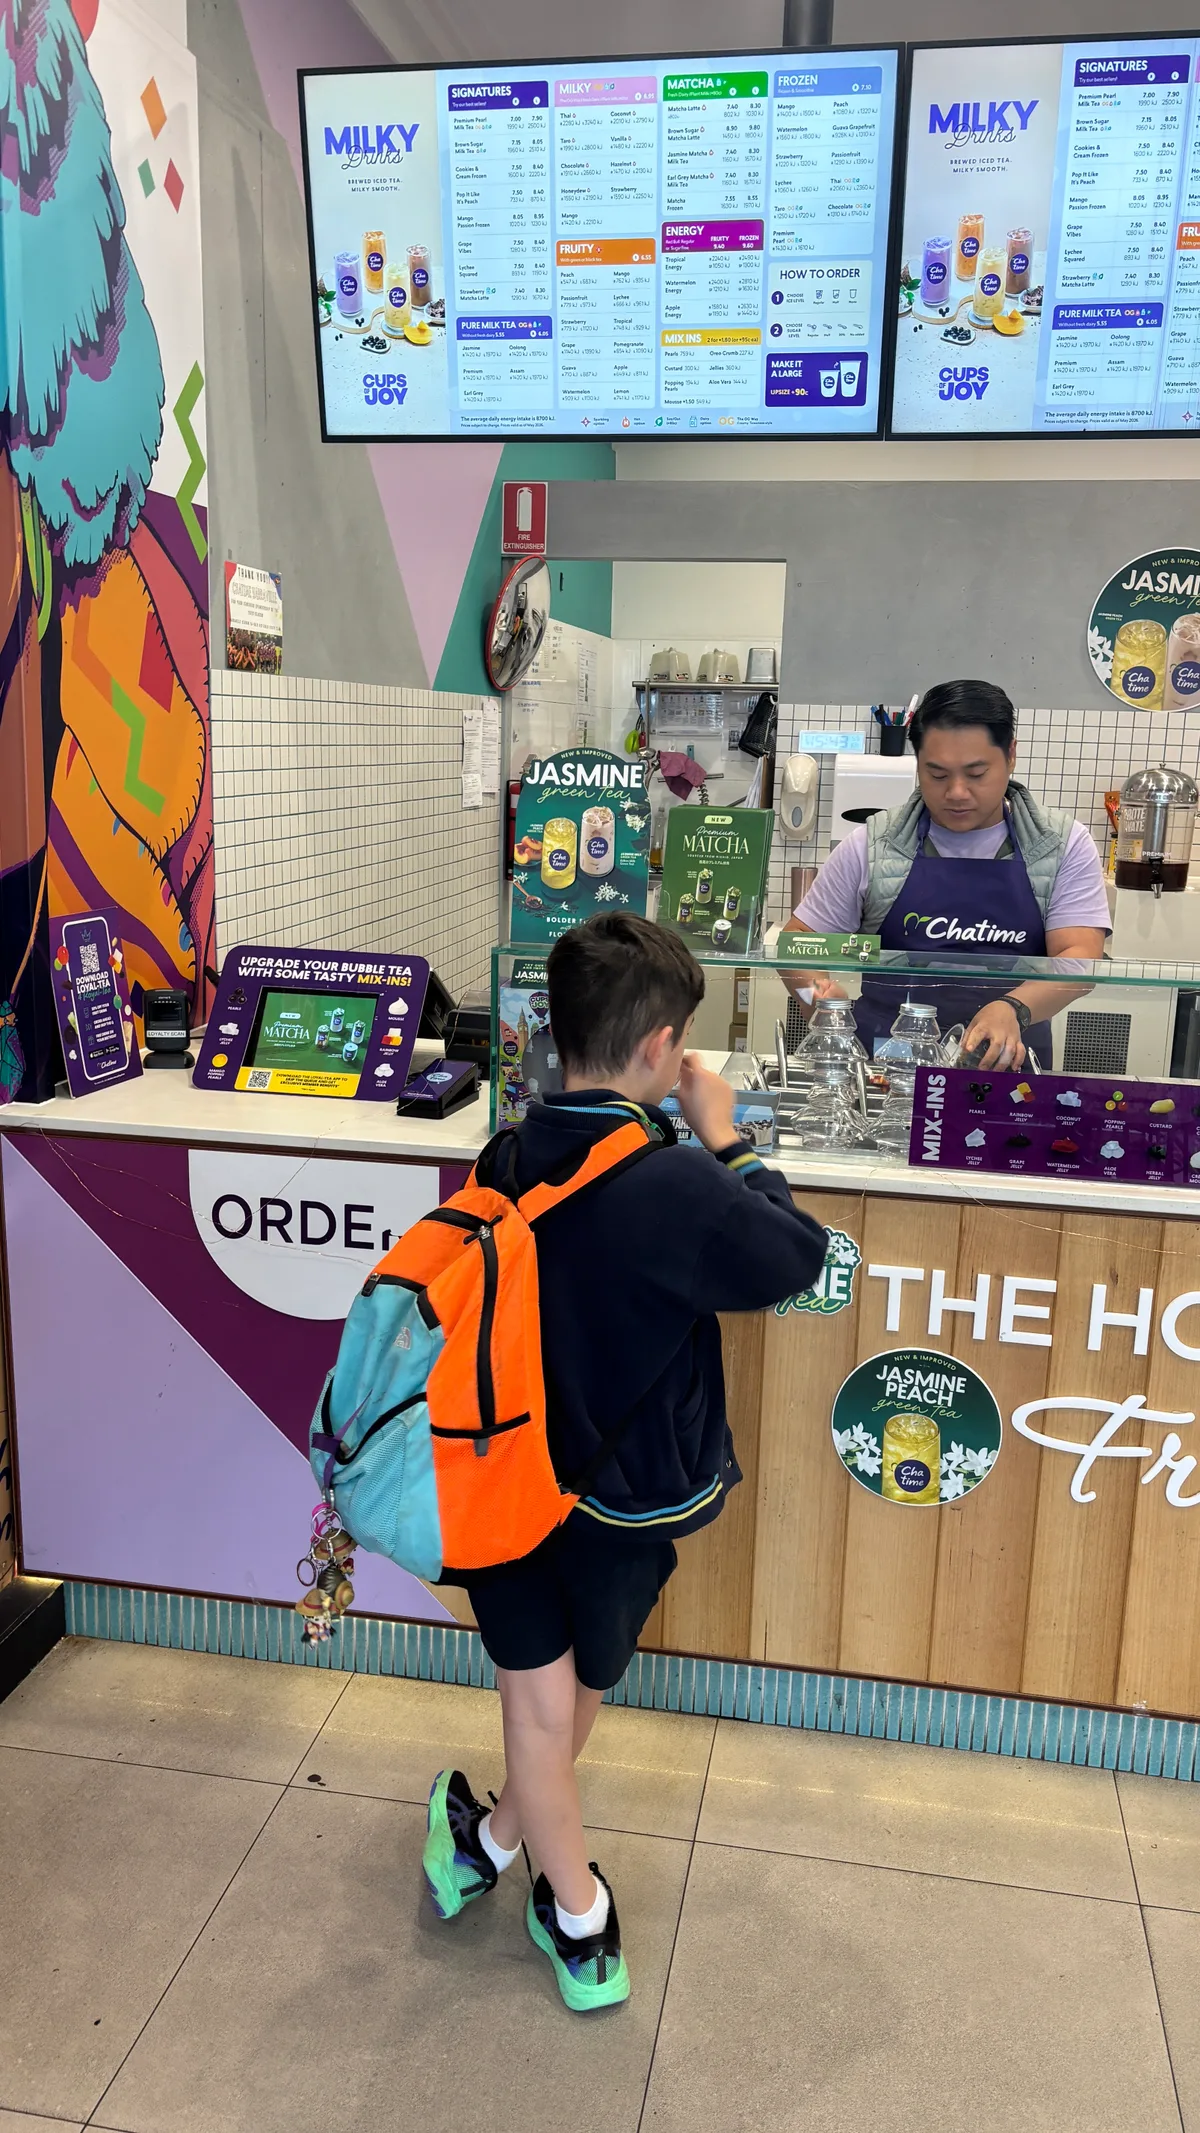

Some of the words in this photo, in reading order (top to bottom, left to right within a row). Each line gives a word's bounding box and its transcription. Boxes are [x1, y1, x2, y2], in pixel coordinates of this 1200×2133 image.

[1079, 60, 1147, 73] SIGNATURES
[668, 78, 714, 89] MATCHA
[778, 75, 818, 86] FROZEN
[452, 86, 512, 98] SIGNATURES
[560, 83, 591, 94] MILKY
[928, 100, 1039, 134] MILKY
[324, 124, 420, 155] MILKY
[944, 122, 1016, 150] Drinks
[341, 144, 403, 170] Drinks
[666, 226, 704, 236] ENERGY
[560, 244, 594, 254] FRUITY
[963, 241, 976, 250] Cha
[1012, 258, 1026, 266] Cha
[780, 270, 807, 279] HOW
[810, 270, 827, 278] TO
[827, 269, 860, 278] ORDER
[930, 267, 944, 276] Cha
[983, 278, 998, 286] Cha
[1059, 309, 1081, 318] PURE
[1082, 309, 1103, 317] MILK
[1105, 308, 1122, 316] TEA
[462, 321, 481, 329] PURE
[482, 320, 500, 329] MILK
[501, 320, 516, 328] TEA
[665, 334, 684, 344] MIX
[686, 334, 701, 343] INS
[795, 360, 802, 368] IT
[771, 370, 777, 378] A
[939, 367, 989, 381] CUPS
[363, 374, 407, 388] CUPS
[364, 388, 408, 405] JOY
[939, 382, 989, 400] JOY
[1152, 559, 1168, 567] NEW
[1178, 558, 1199, 566] IMPRO
[1130, 593, 1185, 607] green
[1128, 672, 1150, 683] Cha
[1177, 677, 1198, 688] time
[1128, 683, 1149, 692] time
[582, 750, 613, 760] IMPROVED
[526, 762, 642, 788] JASMINE
[537, 786, 596, 803] green
[696, 826, 738, 836] Premium
[683, 835, 749, 854] MATCHA
[926, 916, 1027, 944] Chatime
[787, 946, 829, 955] MATCHA
[241, 956, 301, 968] UPGRADE
[303, 960, 338, 971] YOUR
[341, 963, 385, 974] BUBBLE
[388, 966, 412, 976] TEA
[76, 971, 109, 985] DOWNLOAD
[238, 967, 272, 978] WITH
[275, 969, 311, 979] SOME
[313, 971, 352, 983] TASTY
[357, 975, 412, 986] MIX-INS!
[76, 980, 110, 994] LOYAL-TEA
[264, 1026, 310, 1040] MATCHA
[922, 1074, 946, 1161] MIX-INS
[868, 1264, 1057, 1346] THE
[920, 1355, 956, 1370] IMPROVED
[876, 1365, 967, 1393] JASMINE
[885, 1382, 953, 1407] PEACH
[872, 1399, 928, 1414] green
[901, 1466, 924, 1476] Cha
[901, 1476, 924, 1486] time
